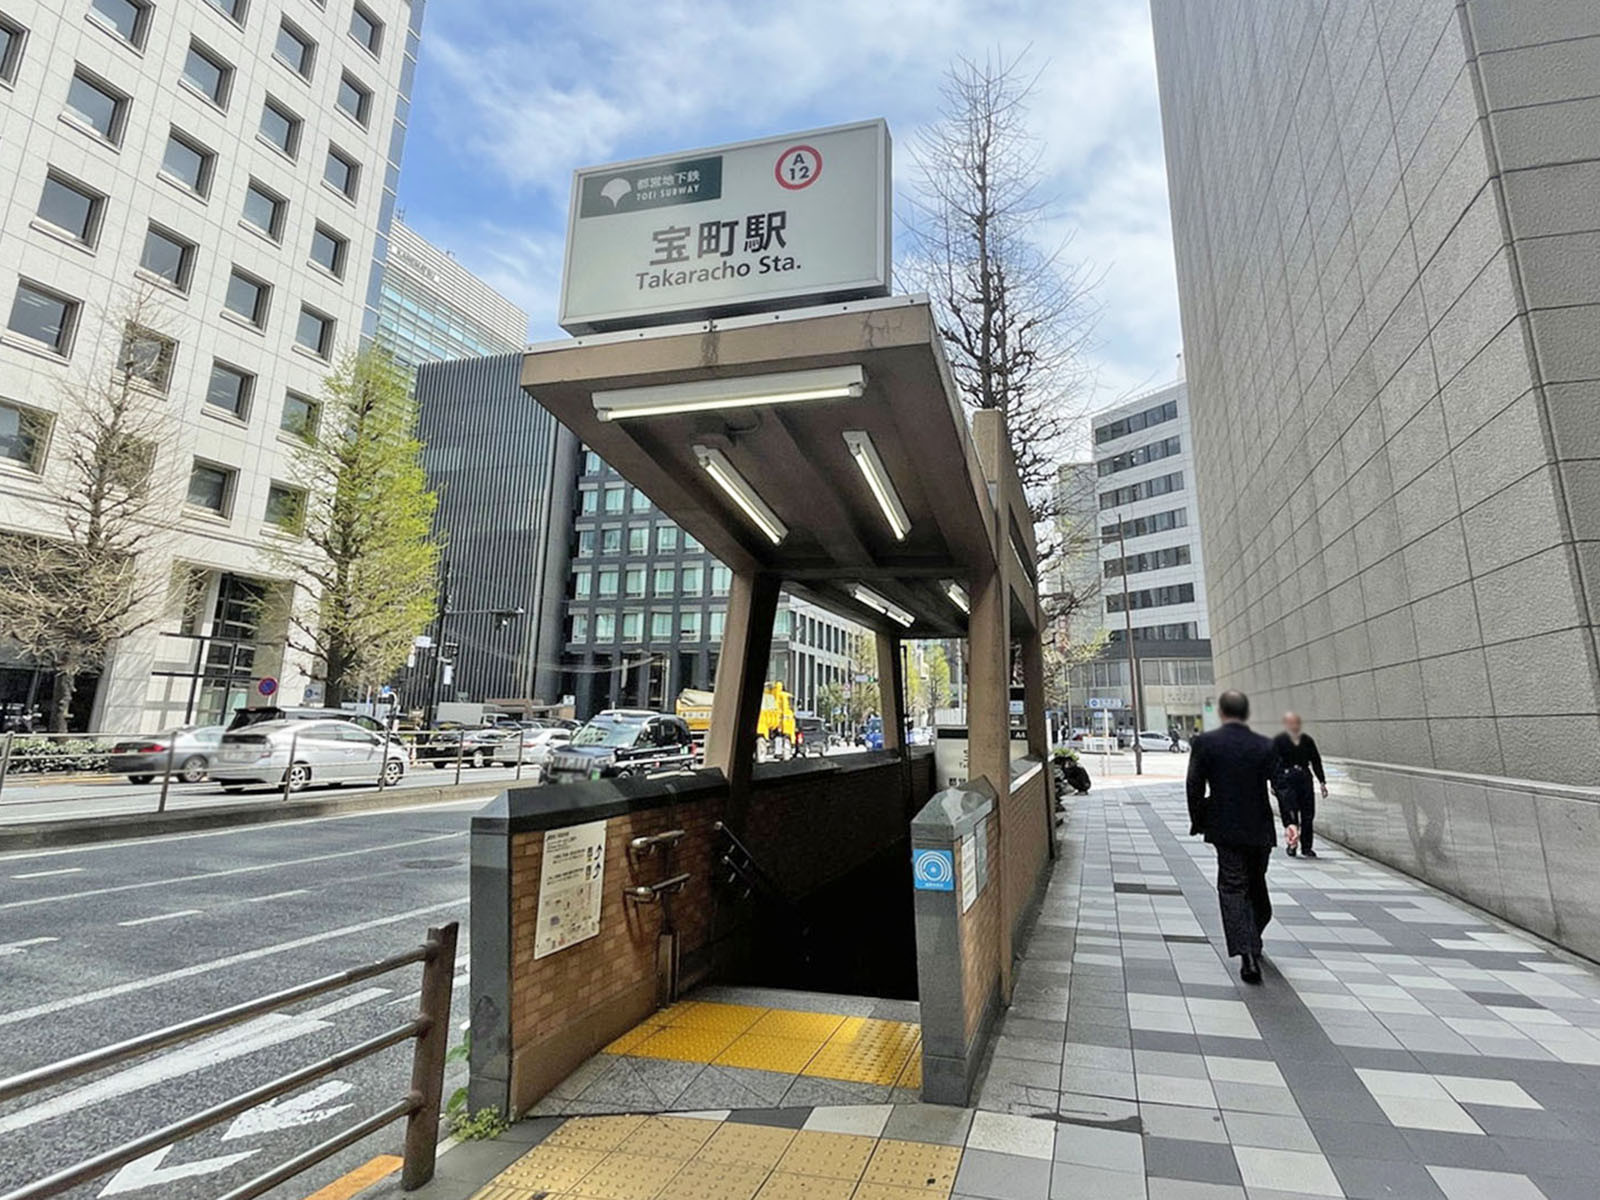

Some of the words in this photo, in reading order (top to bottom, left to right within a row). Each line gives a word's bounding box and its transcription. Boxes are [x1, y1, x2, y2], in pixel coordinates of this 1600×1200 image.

[793, 153, 805, 165] A
[789, 166, 809, 180] 12
[636, 191, 656, 201] TOEI
[660, 184, 700, 198] SUBWAY
[649, 210, 787, 266] 宝町駅
[636, 260, 750, 290] Takaracho
[759, 255, 801, 274] Sta.
